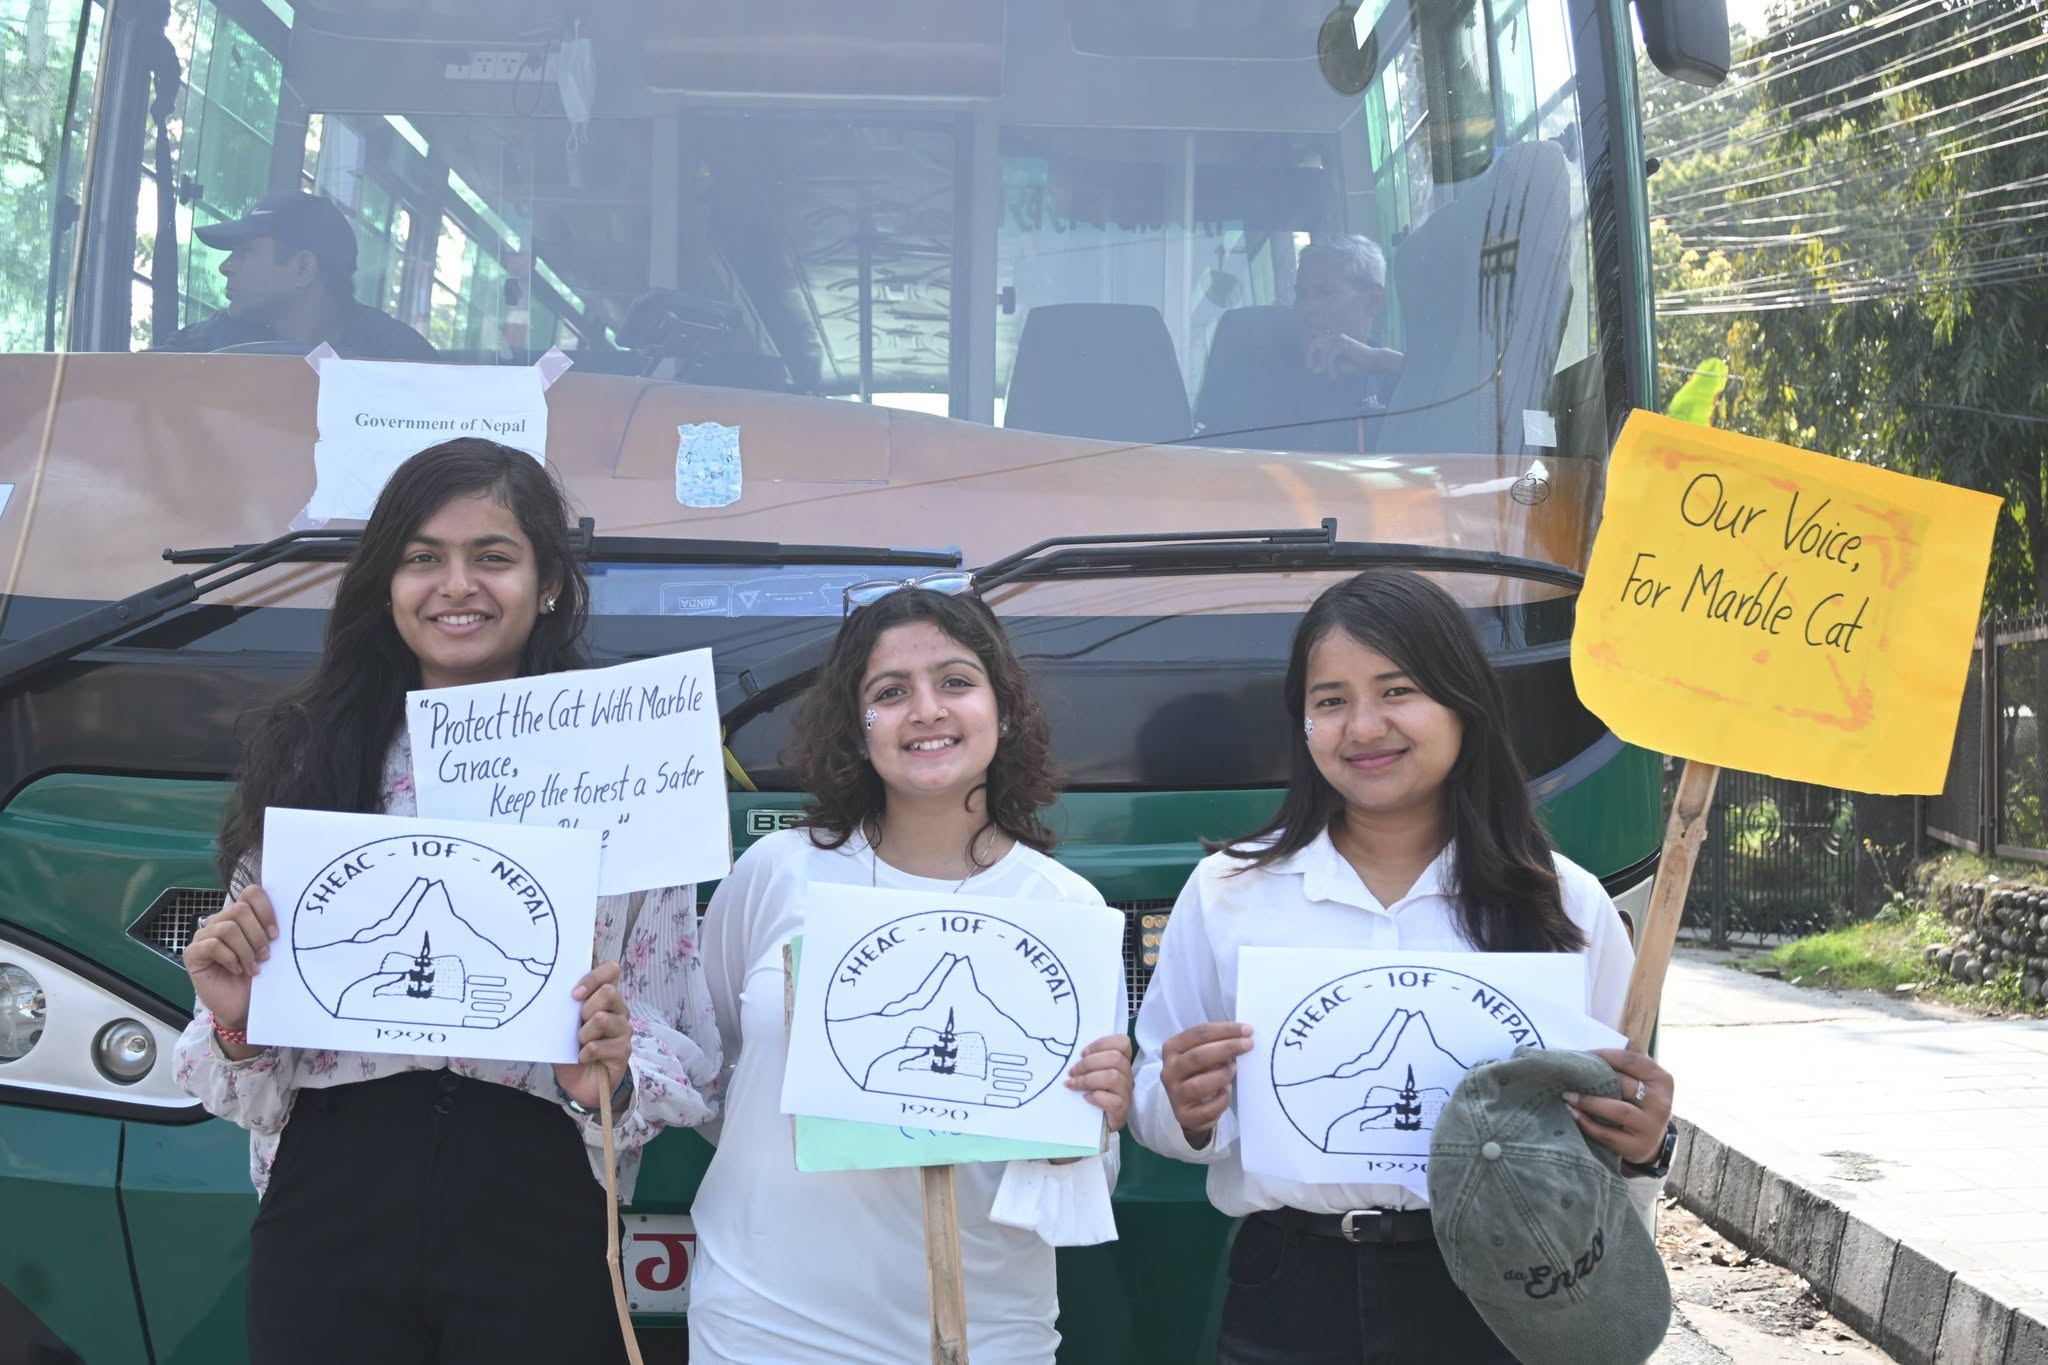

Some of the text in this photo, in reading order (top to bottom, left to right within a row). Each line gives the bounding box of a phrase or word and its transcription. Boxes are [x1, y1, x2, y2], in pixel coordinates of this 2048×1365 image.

[354, 412, 527, 436] Government of Nepal
[1680, 473, 1862, 573] Our Voice,
[1620, 552, 1870, 653] For Marble Cat
[511, 690, 543, 738] the
[548, 688, 586, 731] Cat
[591, 685, 633, 728] With
[637, 674, 704, 723] Marble
[438, 749, 519, 784] Grace,
[489, 782, 537, 825] Keep
[540, 772, 569, 809] the
[632, 780, 646, 796] a
[655, 753, 705, 794] Safer
[305, 852, 375, 915] SHEAC
[411, 840, 462, 858] IOF
[490, 860, 550, 926] NEPAL
[839, 926, 906, 988] SHEAC
[940, 916, 988, 935] IOF
[1014, 937, 1072, 1005] NEPAL
[376, 1028, 447, 1044] 1990
[1283, 984, 1353, 1051] SHEAC
[1387, 971, 1438, 988] IOF
[900, 1102, 969, 1121] 1990
[1503, 1225, 1605, 1299] da Enzo
